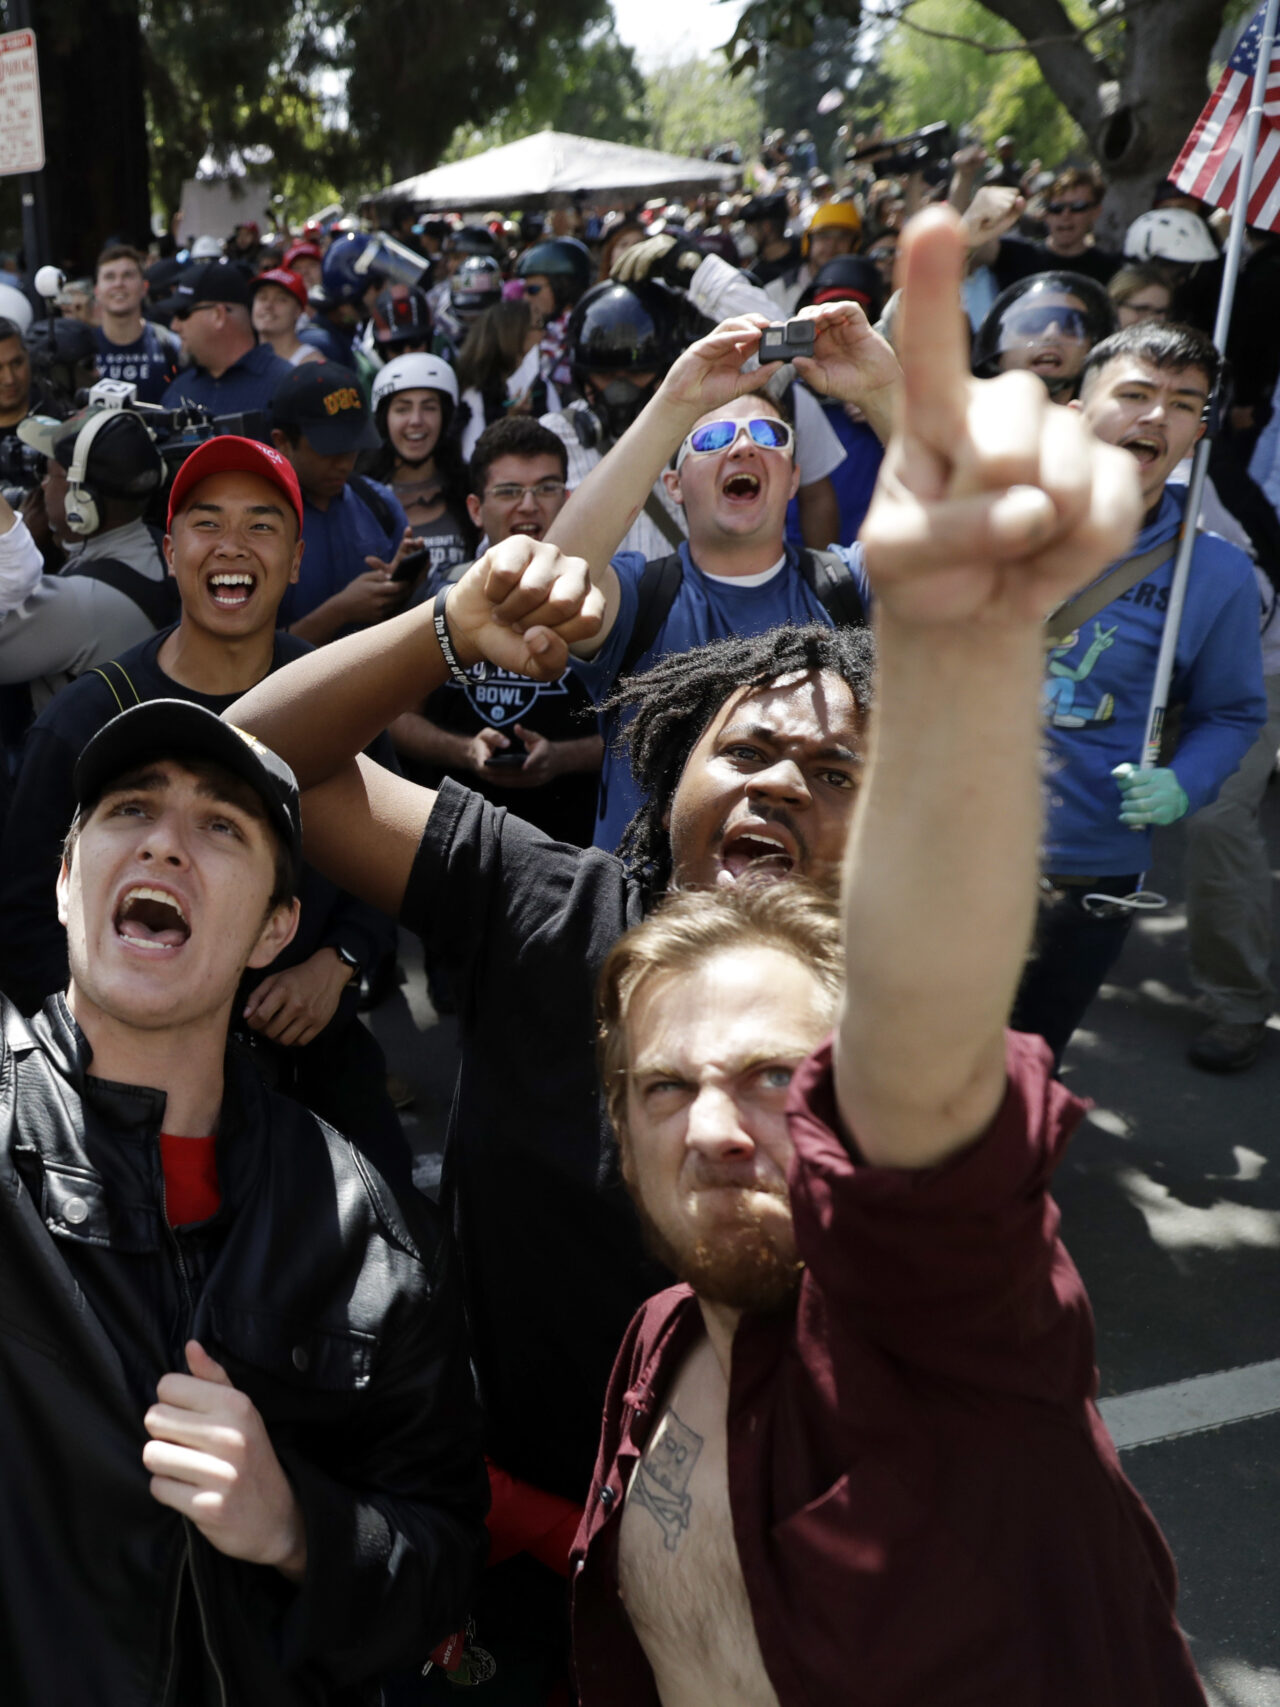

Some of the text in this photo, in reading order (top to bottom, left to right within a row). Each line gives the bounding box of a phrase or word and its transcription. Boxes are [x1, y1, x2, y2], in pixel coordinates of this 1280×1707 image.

[434, 614, 446, 635] The
[438, 636, 456, 665] Power
[451, 665, 464, 678] of
[475, 686, 523, 706] BOWL
